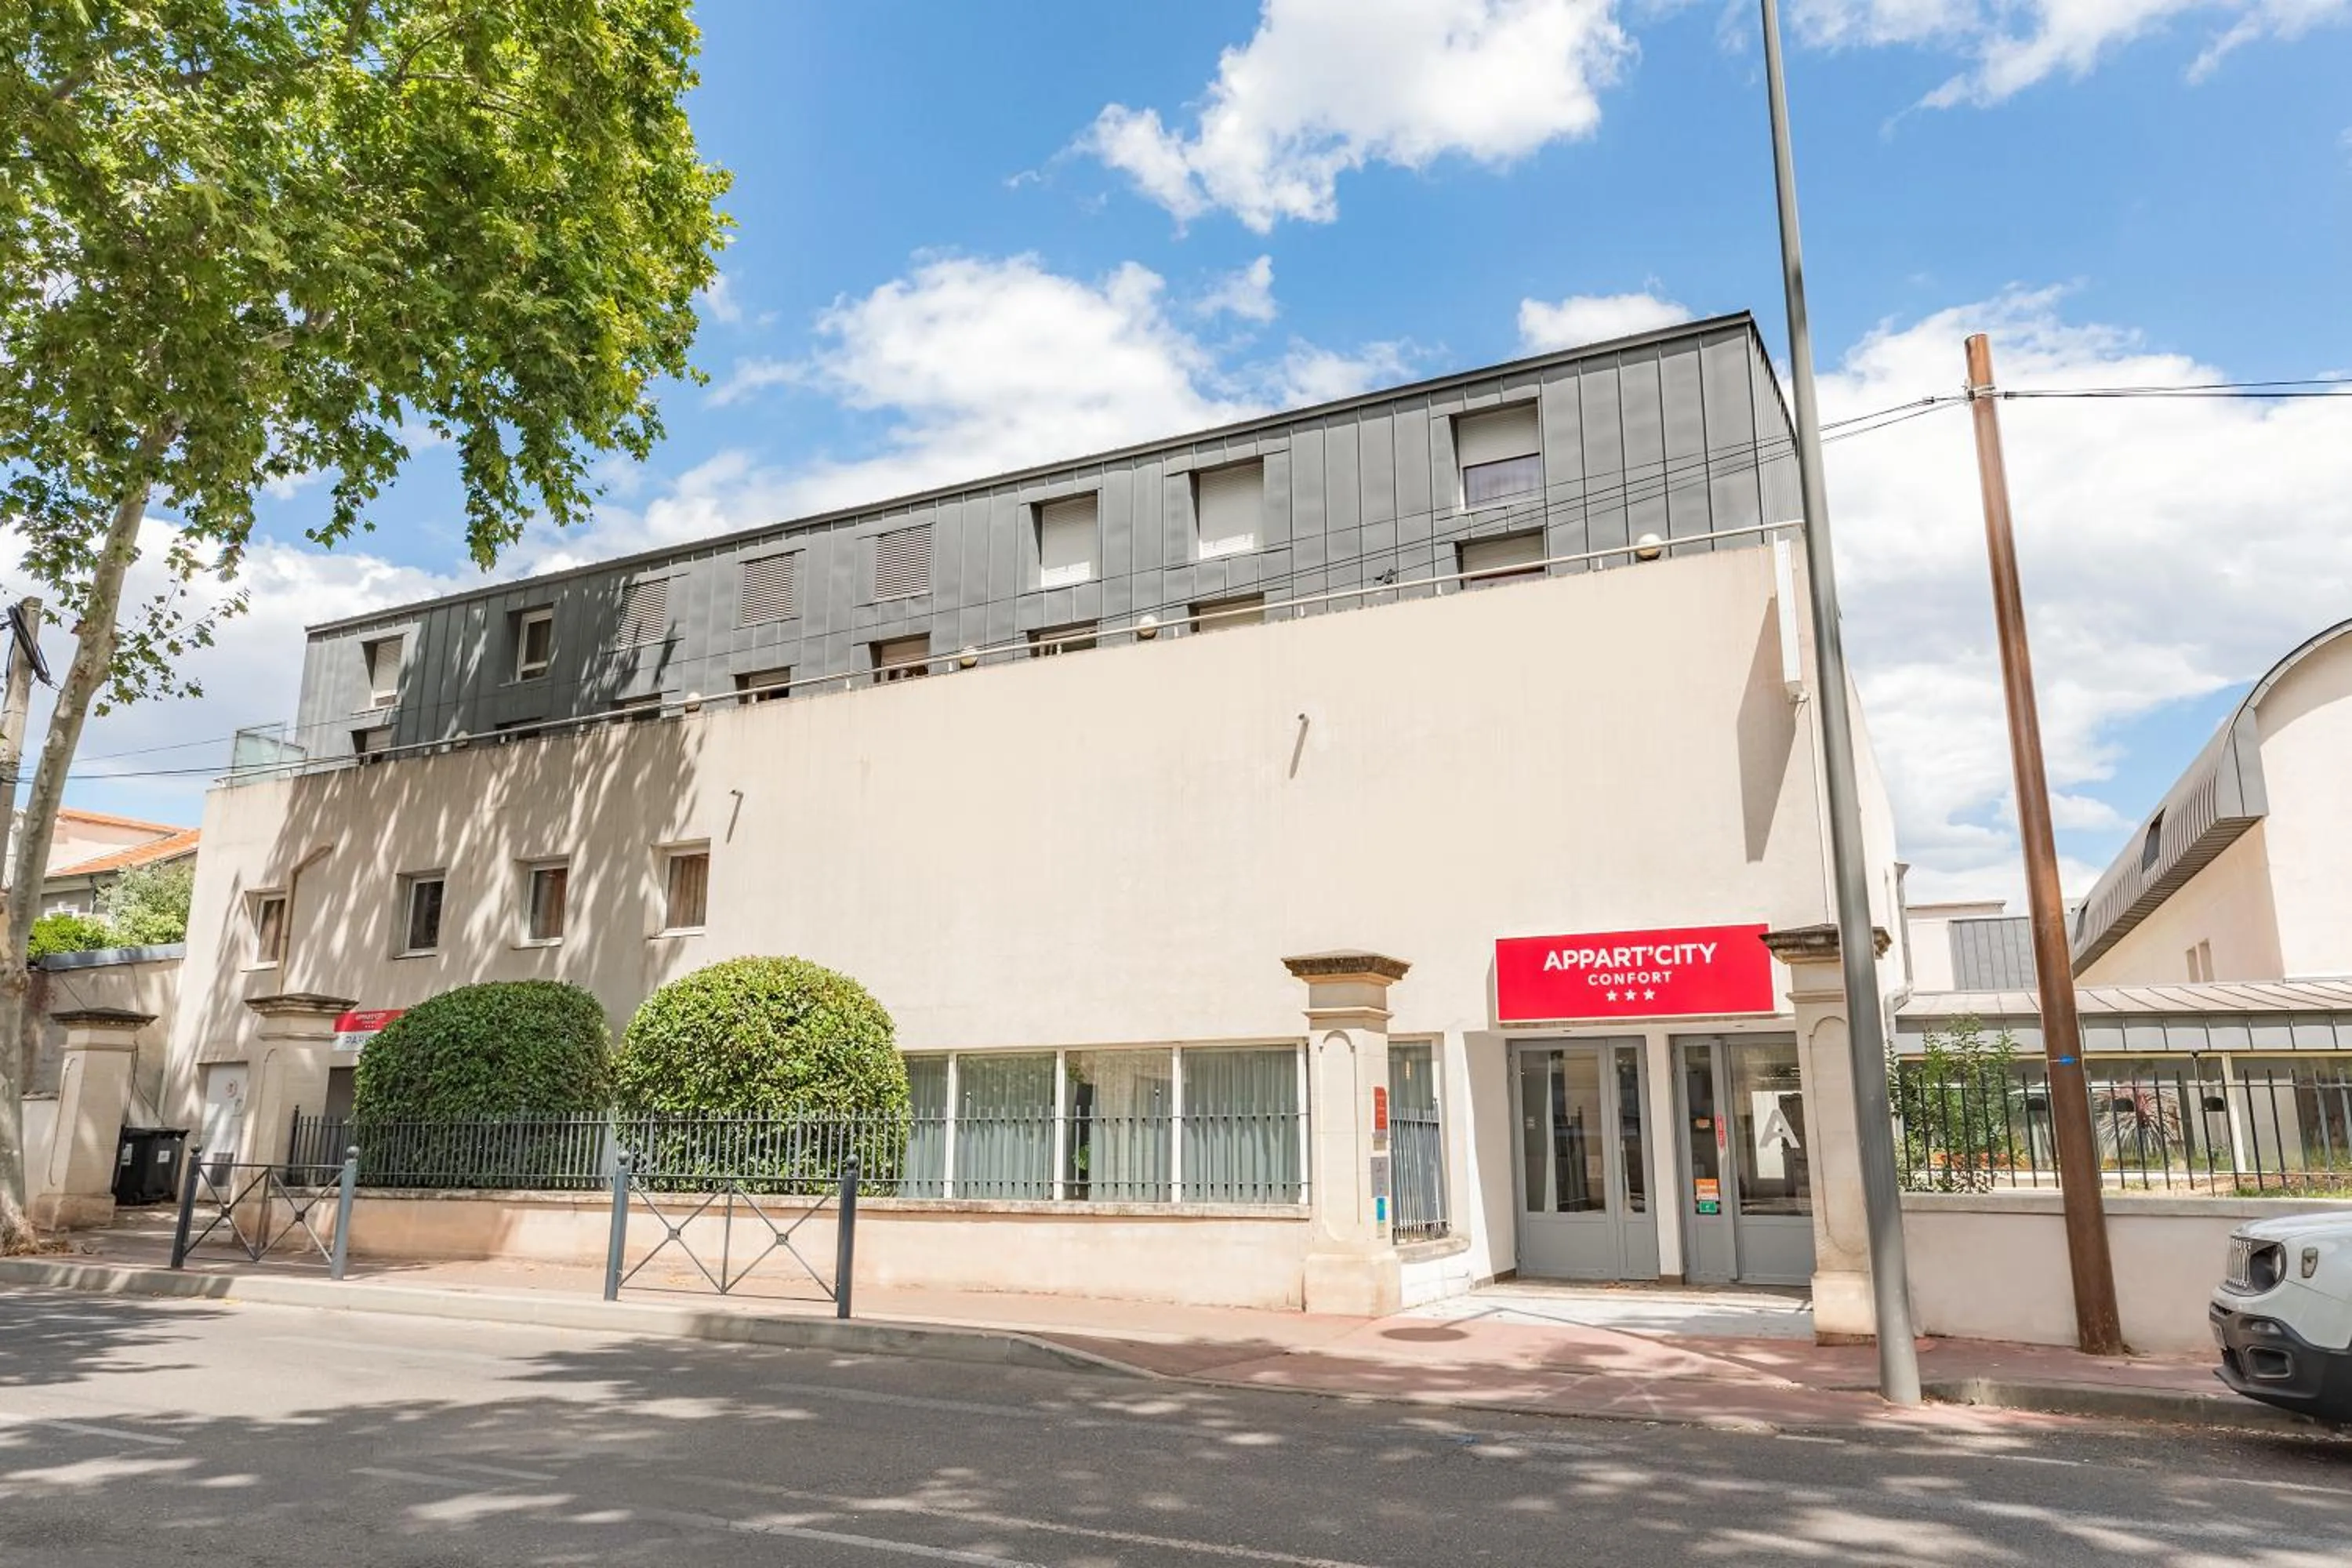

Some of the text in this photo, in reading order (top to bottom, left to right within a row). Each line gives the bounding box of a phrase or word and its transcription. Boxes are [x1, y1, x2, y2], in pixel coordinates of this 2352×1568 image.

[1543, 942, 1718, 971] APPART'CITY
[1588, 970, 1672, 985] CONFORT
[1759, 1108, 1801, 1149] A
